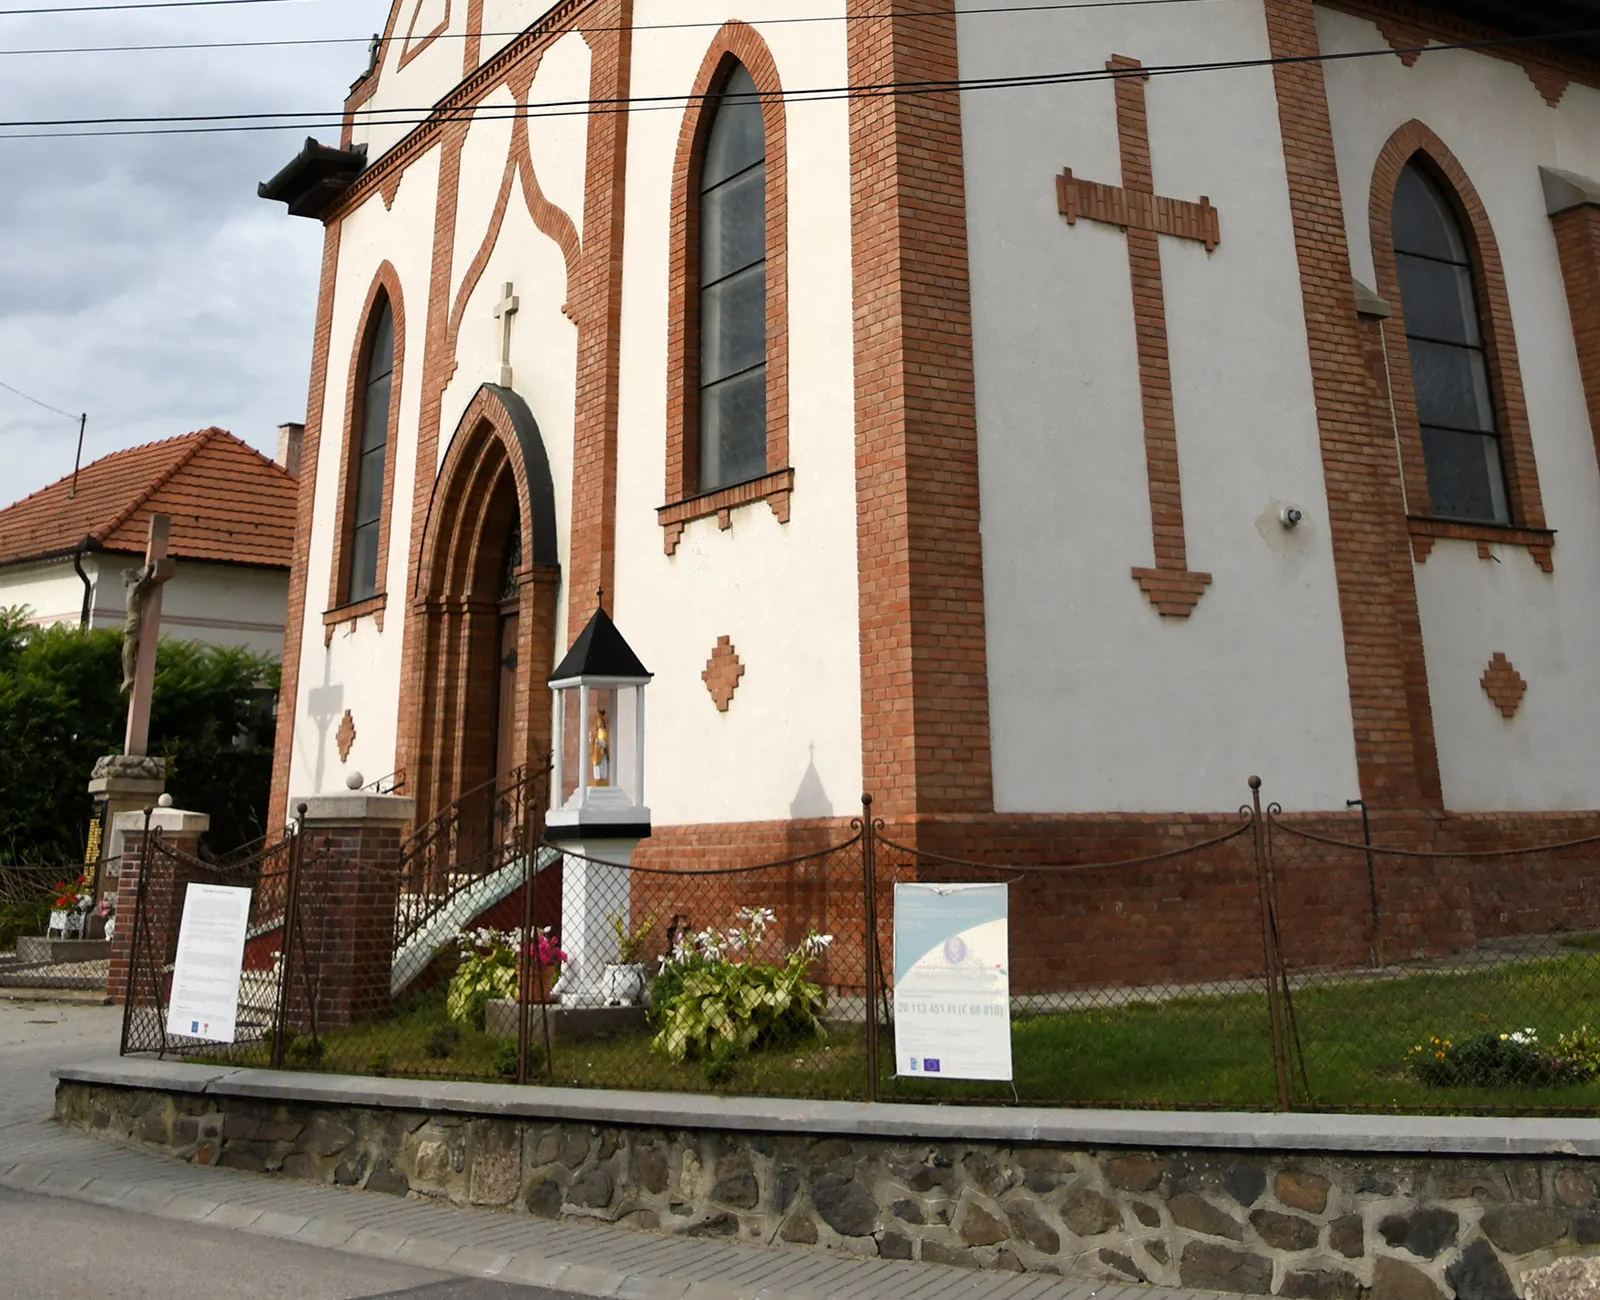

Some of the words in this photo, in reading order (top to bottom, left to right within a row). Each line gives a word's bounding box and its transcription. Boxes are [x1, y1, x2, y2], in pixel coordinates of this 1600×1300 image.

[898, 1002, 909, 1013] 20
[912, 1002, 927, 1014] 113
[930, 1003, 944, 1014] 451
